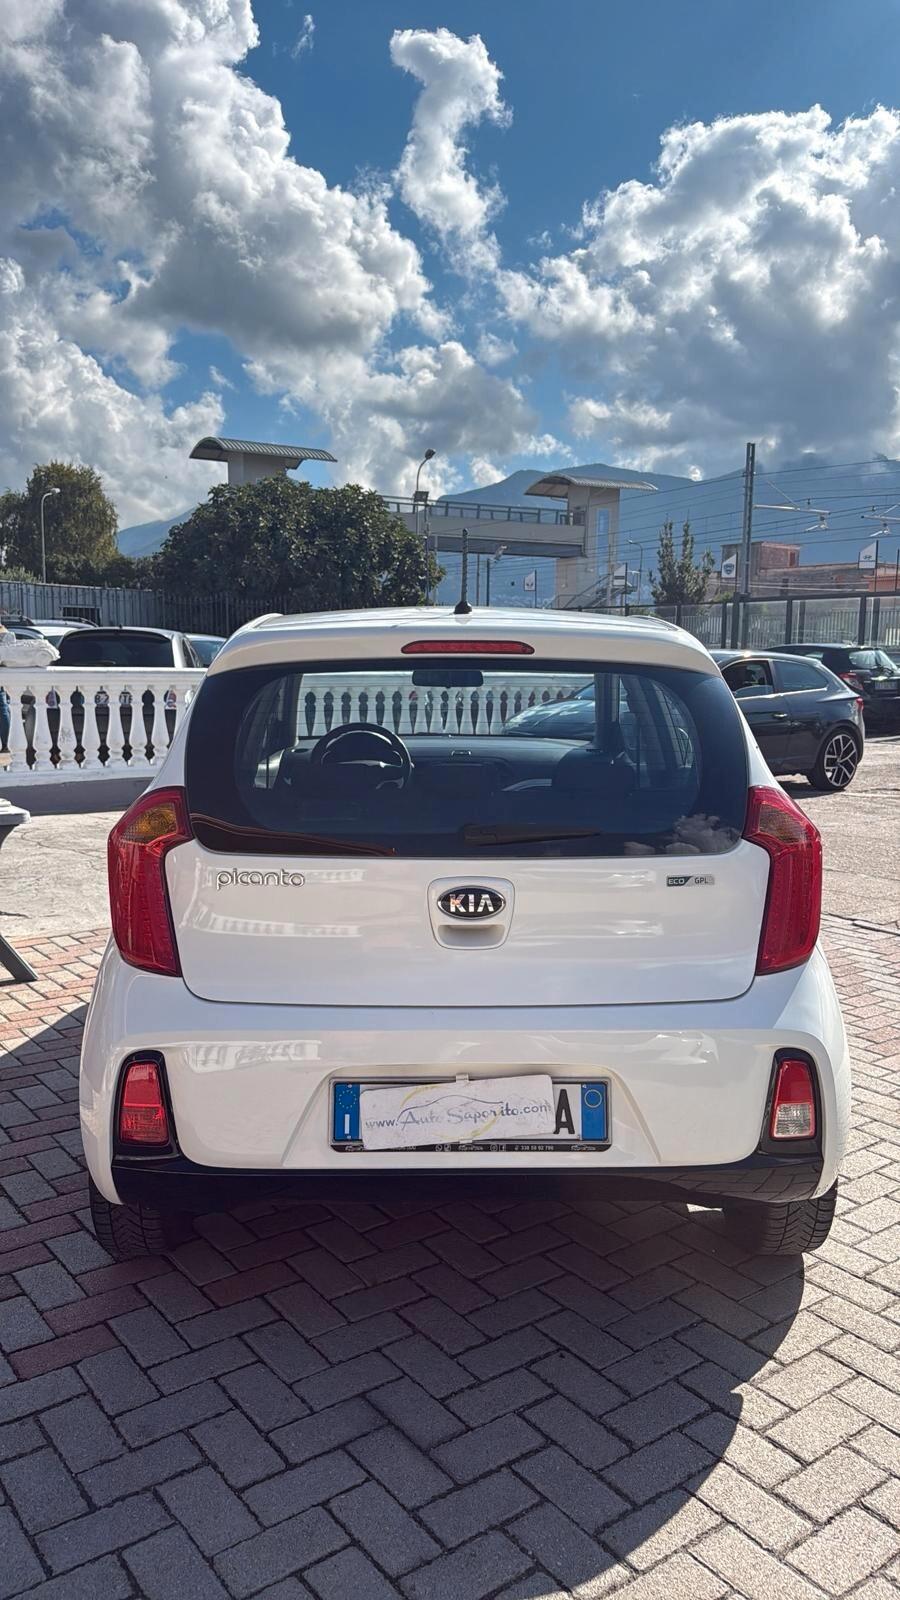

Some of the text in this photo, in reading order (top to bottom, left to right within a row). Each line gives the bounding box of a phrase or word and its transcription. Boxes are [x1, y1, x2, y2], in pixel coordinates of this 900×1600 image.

[216, 867, 305, 891] picanto
[694, 877, 708, 885] GPL
[448, 893, 495, 914] KIA
[553, 1088, 575, 1135] A
[344, 1113, 350, 1135] I
